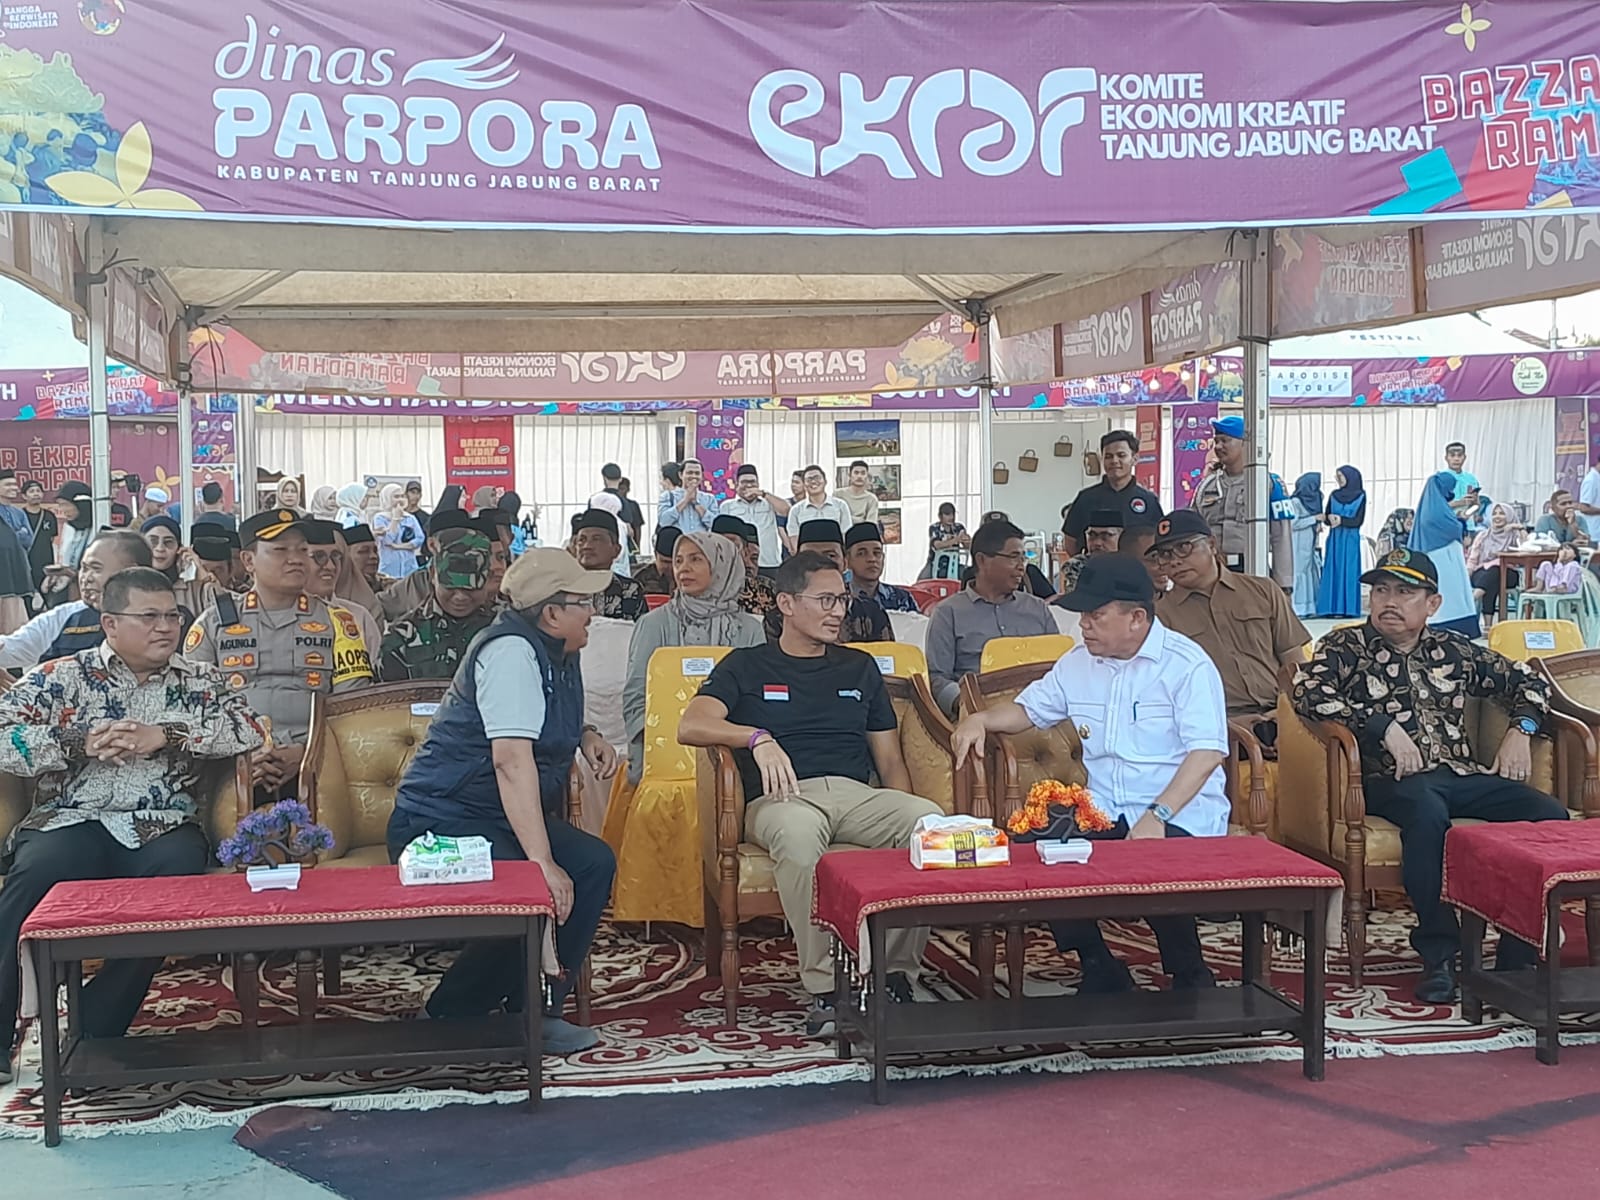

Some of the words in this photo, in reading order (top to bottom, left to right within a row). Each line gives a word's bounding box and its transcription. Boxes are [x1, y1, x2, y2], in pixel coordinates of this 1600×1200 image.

[4, 5, 41, 15] BANGGA
[9, 11, 58, 21] BERWISATA
[214, 14, 397, 86] dinas
[1100, 73, 1203, 100] KOMITE
[1420, 54, 1600, 124] BAZZA
[1101, 102, 1233, 131] EKONOMI
[1238, 99, 1346, 128] KREATIF
[212, 88, 662, 170] PARPORA
[1102, 131, 1231, 160] TANJUNG
[1234, 128, 1342, 157] JABUNG
[1350, 125, 1437, 153] BARAT
[1483, 113, 1600, 171] RAM
[217, 164, 360, 185] KABUPATEN
[370, 170, 478, 189] TANJUNG
[488, 173, 578, 191] JABUNG
[588, 176, 661, 193] BARAT
[36, 381, 91, 400] BAZZA
[107, 375, 146, 389] KRAF
[1277, 371, 1348, 380] ARODISE
[1282, 383, 1333, 392] STORE
[28, 445, 92, 468] EKRA
[295, 636, 332, 648] POLRI
